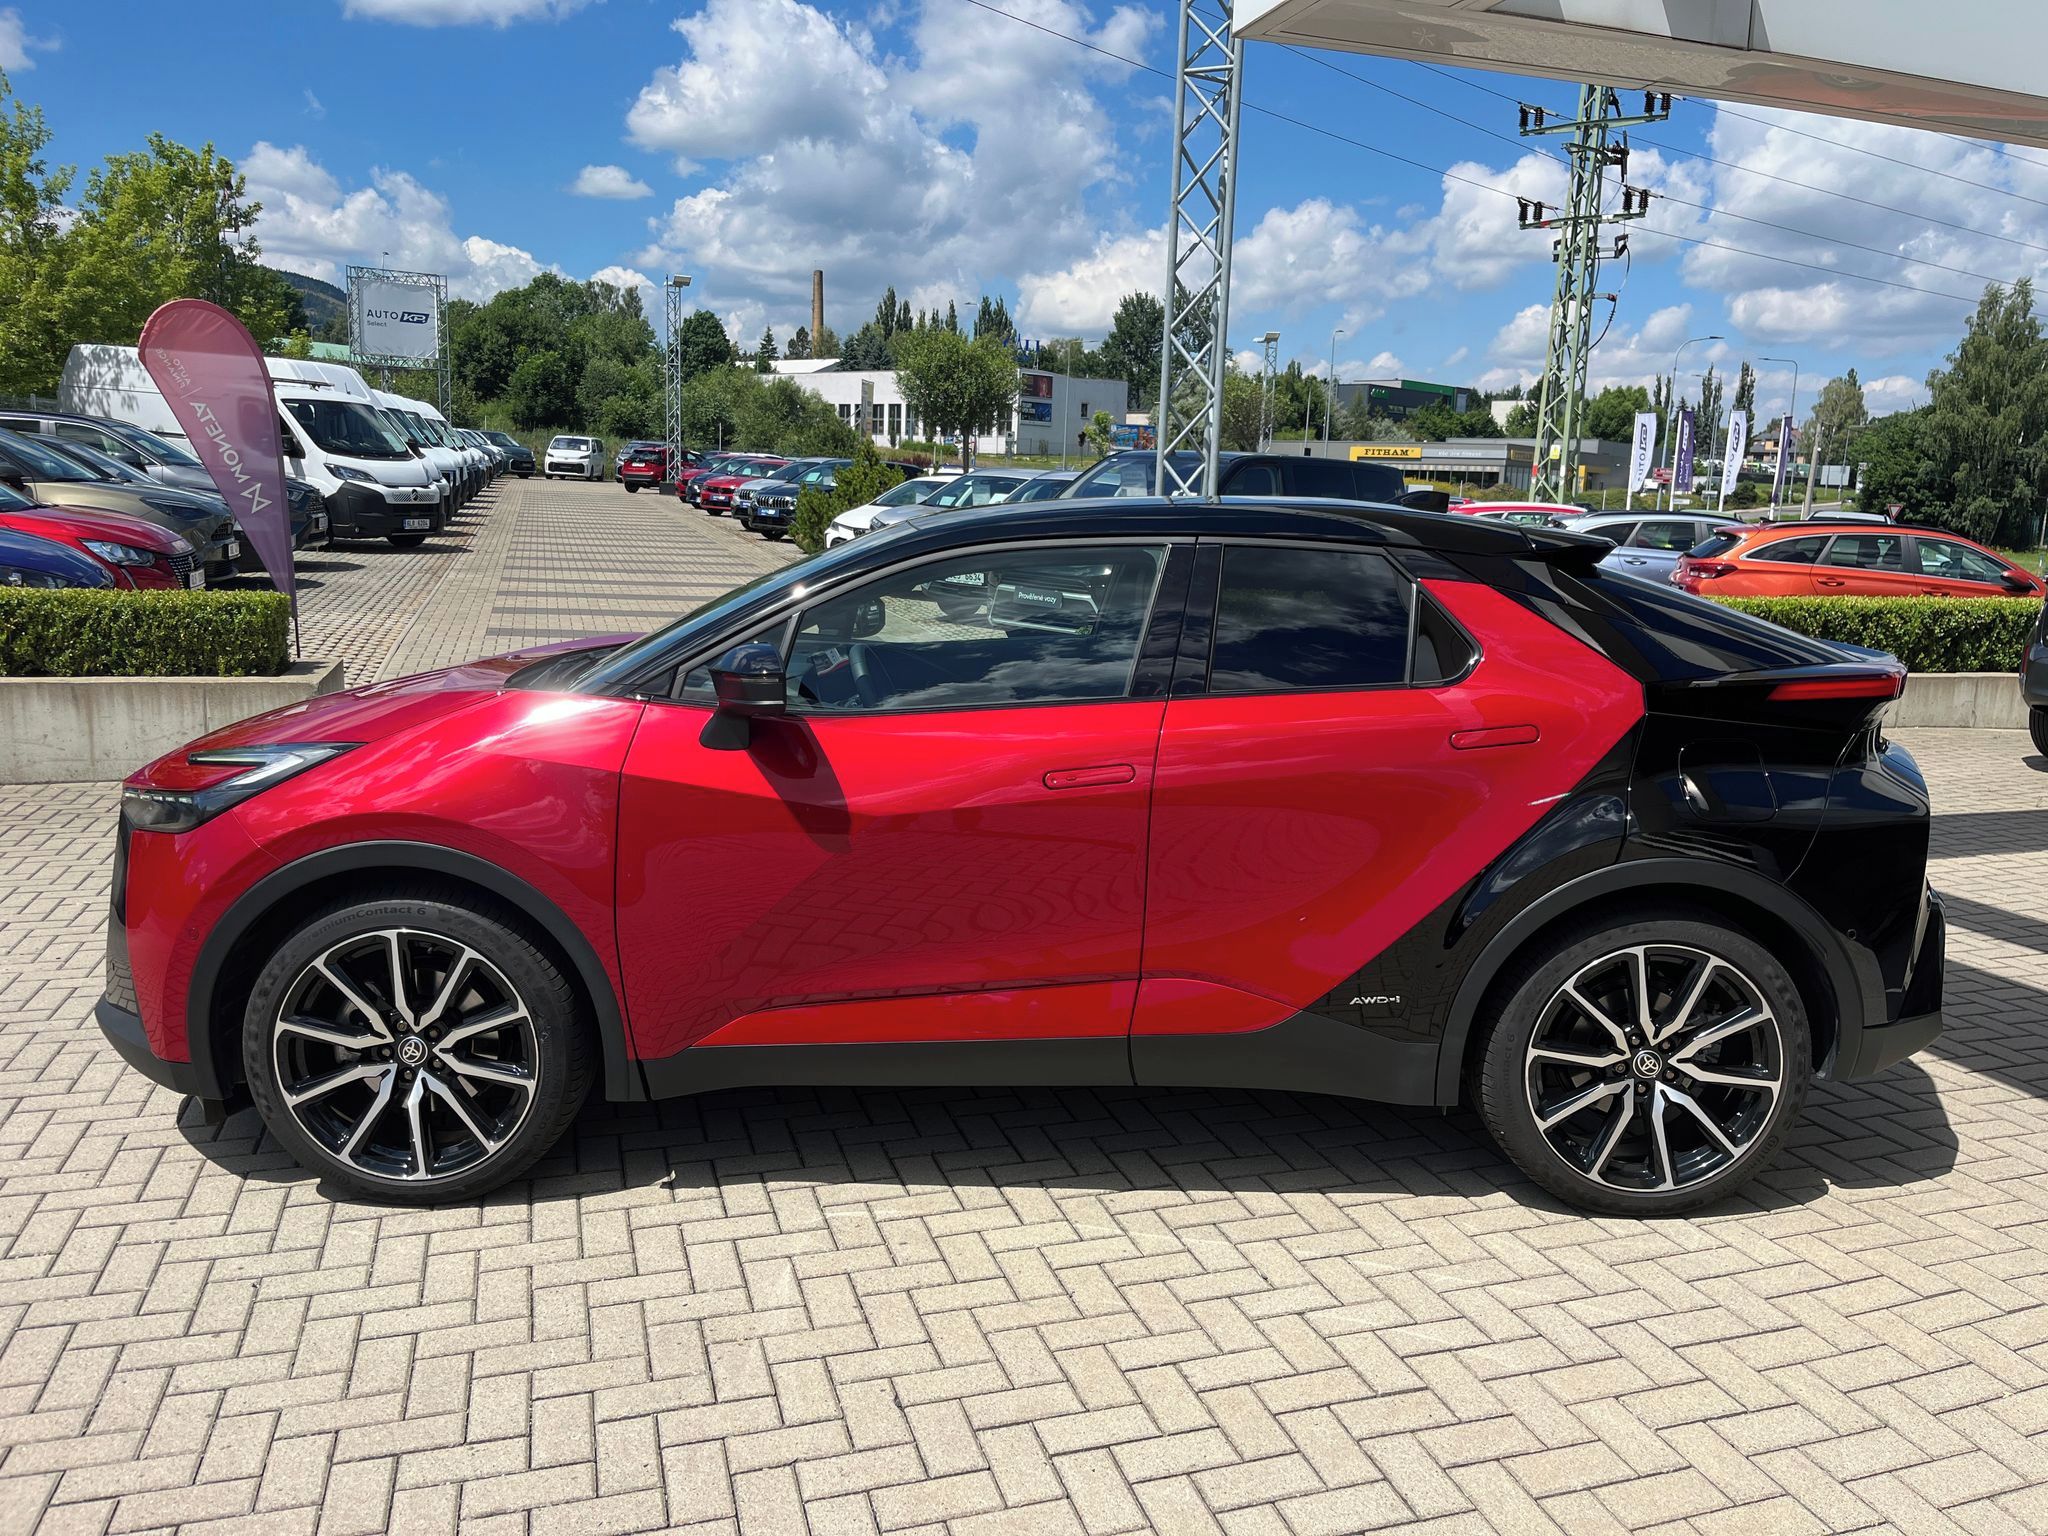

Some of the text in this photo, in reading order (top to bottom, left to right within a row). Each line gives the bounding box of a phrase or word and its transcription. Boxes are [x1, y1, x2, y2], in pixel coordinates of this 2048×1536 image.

[366, 309, 399, 320] AUTO
[1364, 448, 1409, 456] FITHAM
[1044, 596, 1057, 605] vozy
[416, 907, 427, 916] 6
[1350, 995, 1400, 1005] AWD-i
